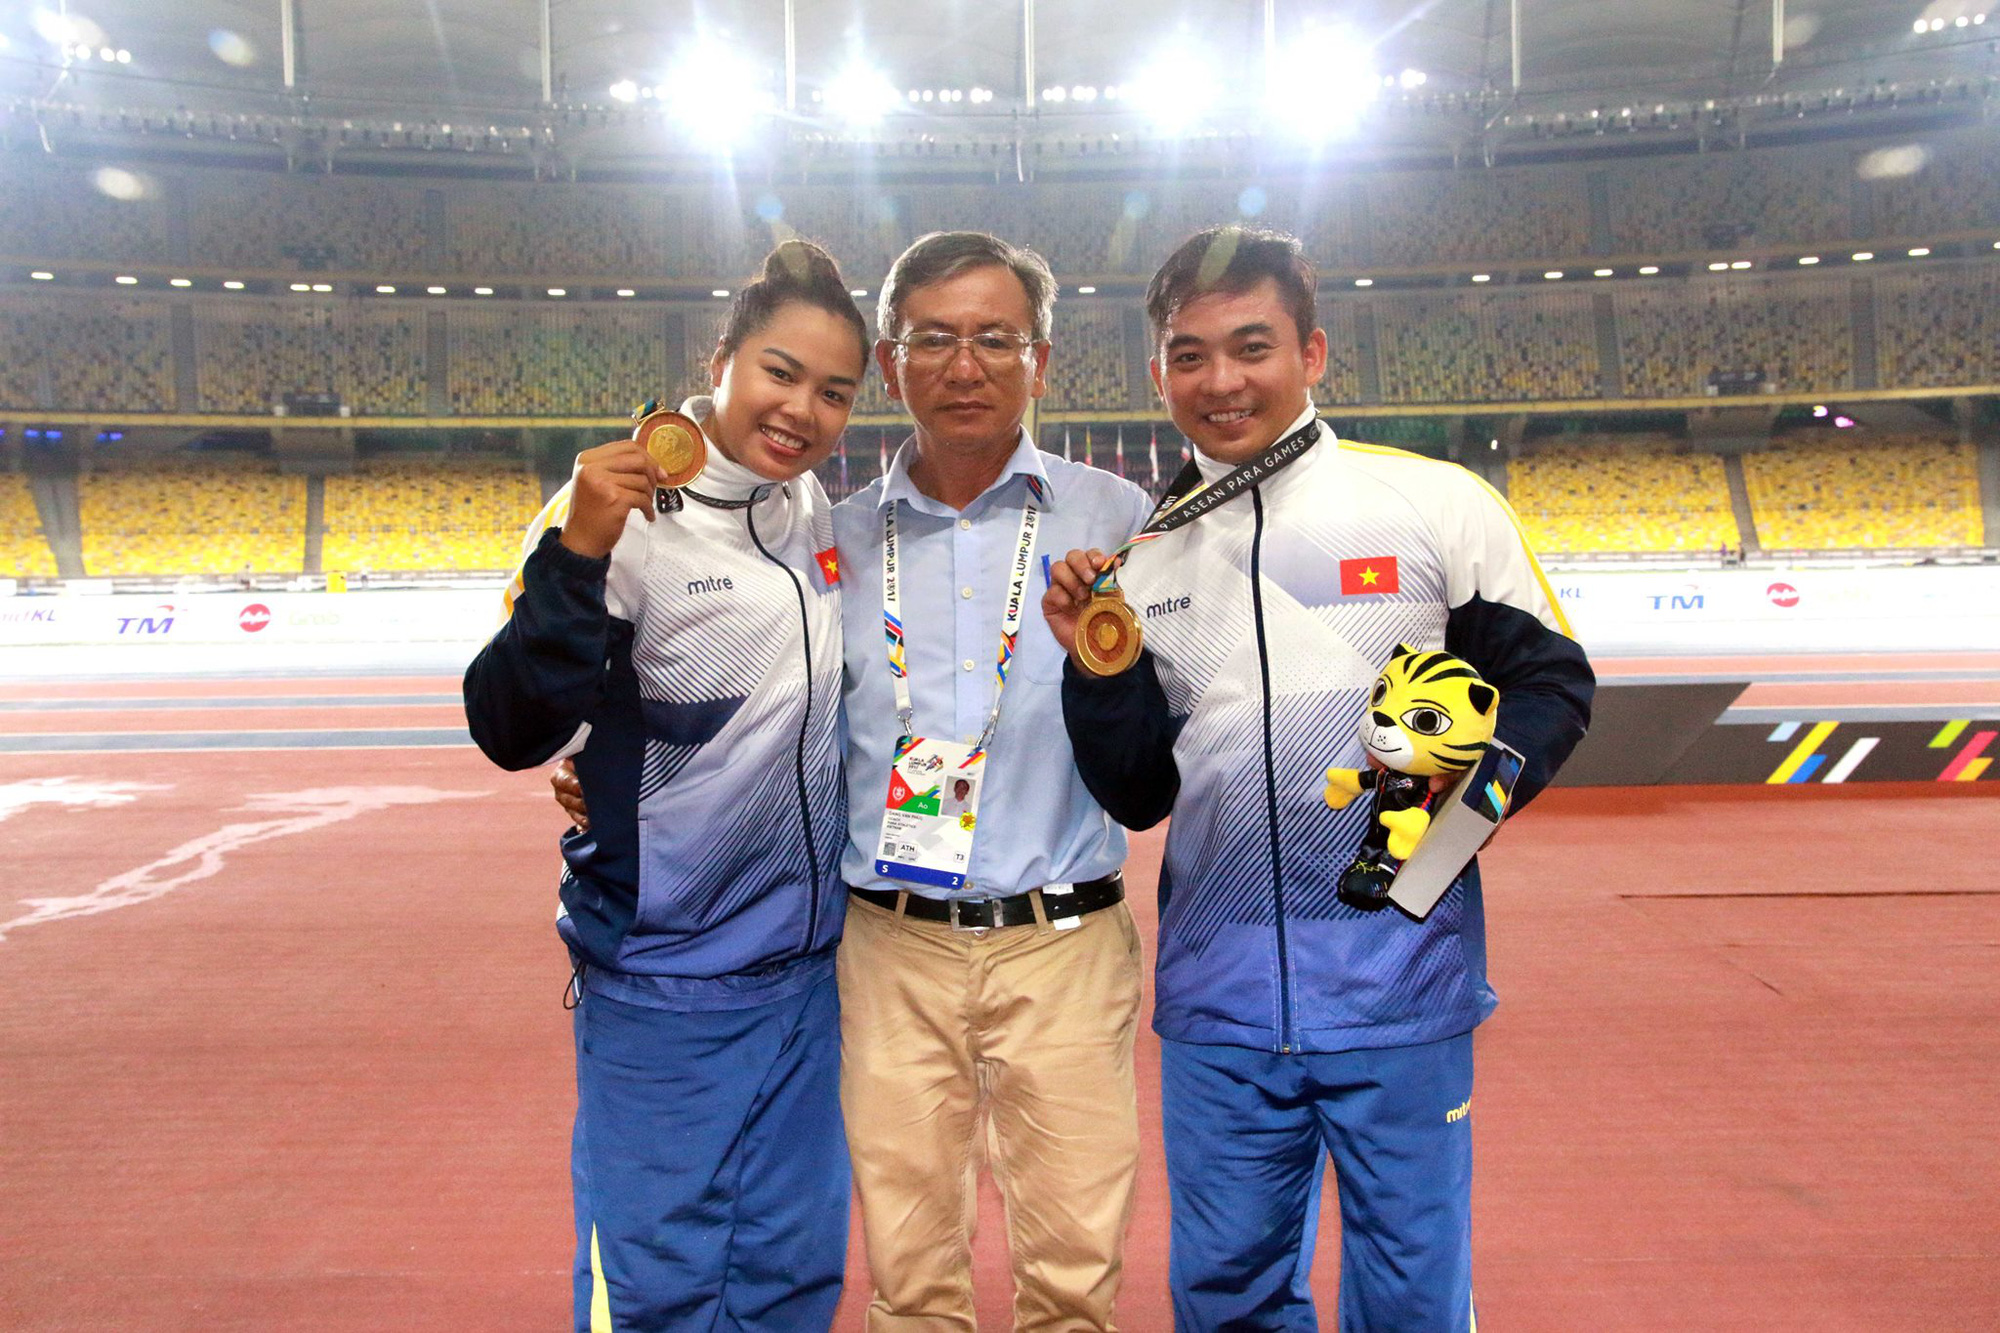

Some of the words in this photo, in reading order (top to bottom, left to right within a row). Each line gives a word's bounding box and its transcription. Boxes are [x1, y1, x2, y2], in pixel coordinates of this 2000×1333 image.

[1183, 487, 1226, 518] ASEAN
[1226, 465, 1263, 491] PARA
[1264, 436, 1305, 468] GAMES
[1025, 504, 1038, 529] 2017
[886, 530, 896, 574] LUMPUR
[1015, 531, 1032, 577] LUMPUR
[688, 576, 733, 595] mitre
[1007, 580, 1024, 621] KUALA
[1146, 597, 1191, 618] mitre
[1647, 595, 1704, 610] TM
[117, 617, 174, 635] TM
[956, 853, 965, 861] T3
[882, 864, 889, 874] S
[952, 876, 959, 886] 2
[1446, 1096, 1471, 1123] mit
